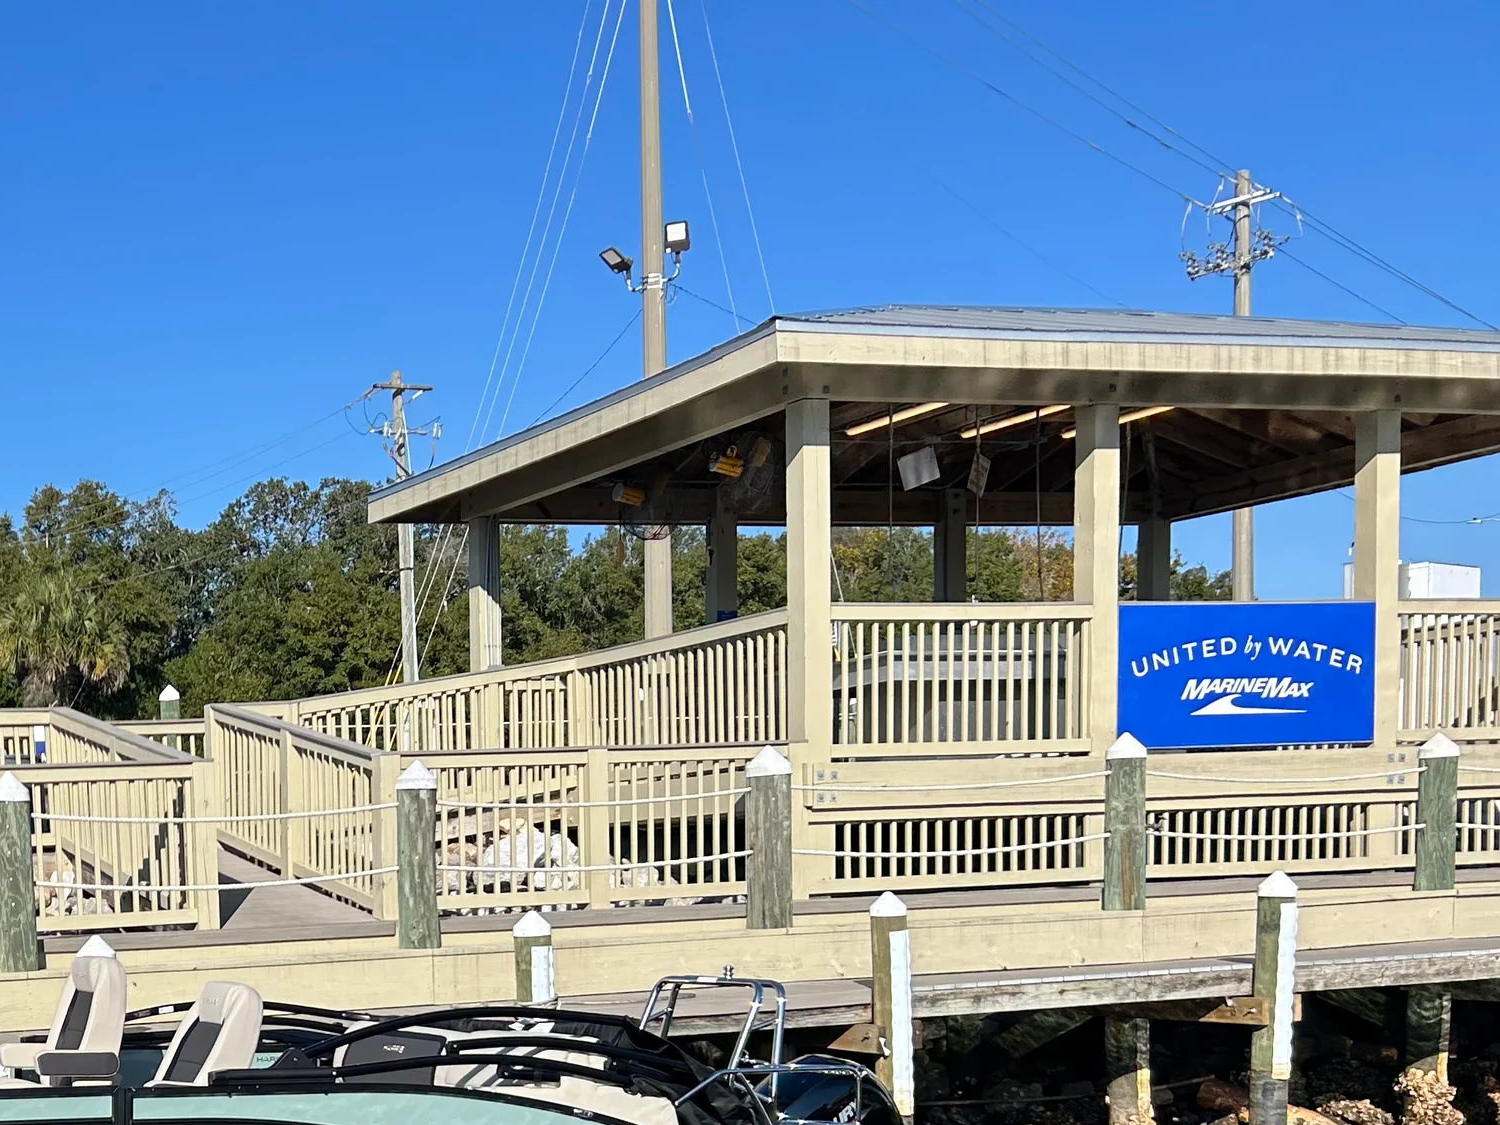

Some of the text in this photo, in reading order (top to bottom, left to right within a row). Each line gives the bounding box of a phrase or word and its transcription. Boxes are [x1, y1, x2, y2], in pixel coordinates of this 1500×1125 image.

[1130, 634, 1364, 677] UNITED by WATER
